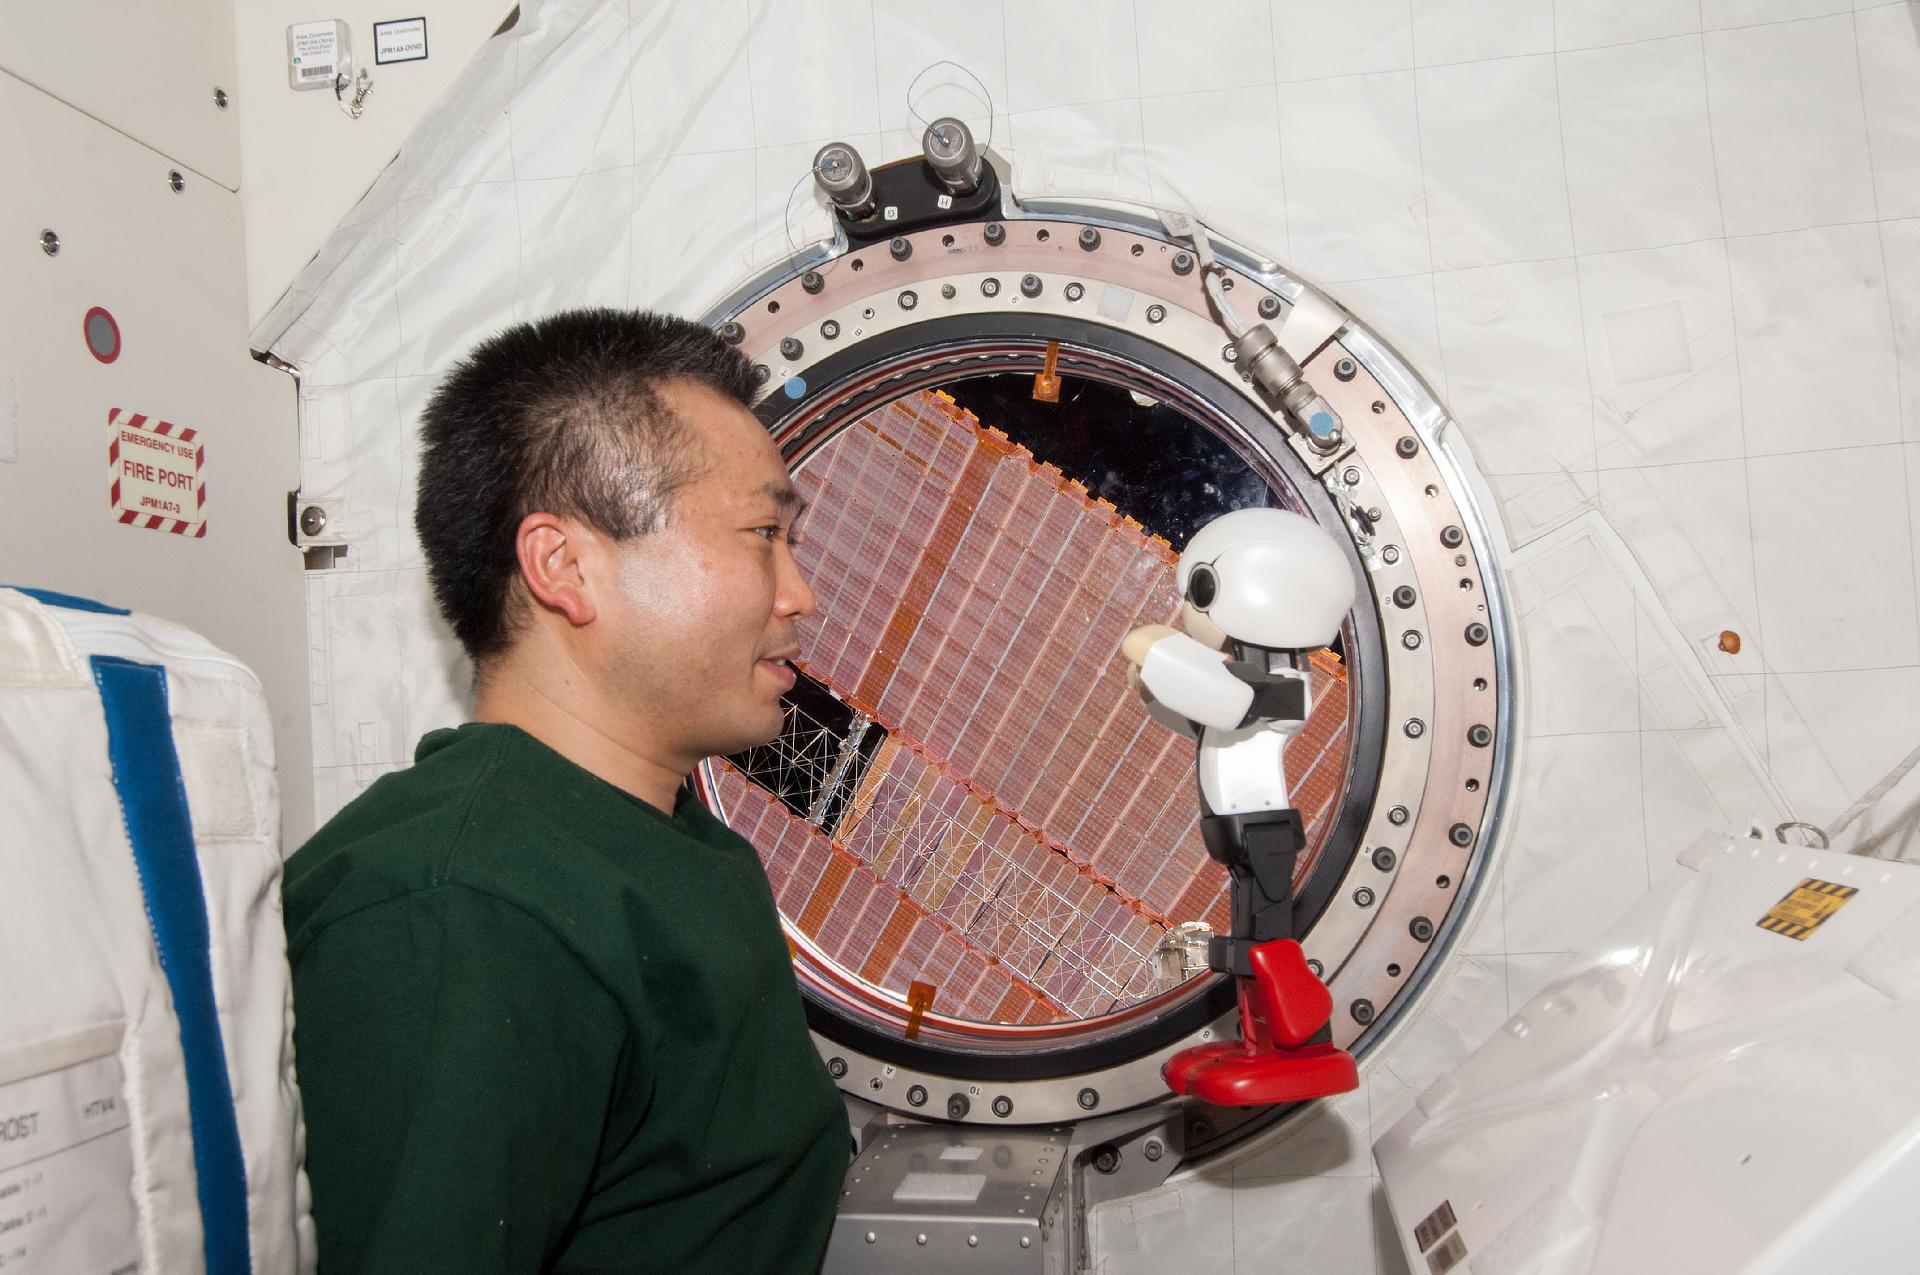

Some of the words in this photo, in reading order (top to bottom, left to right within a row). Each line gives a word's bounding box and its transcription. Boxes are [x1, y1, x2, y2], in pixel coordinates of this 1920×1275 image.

[121, 431, 175, 454] EMERGENCY
[177, 446, 194, 459] USE
[124, 460, 154, 482] FIRE
[158, 469, 194, 491] PORT
[140, 496, 181, 514] JPM1A7-3
[970, 1086, 981, 1095] 10
